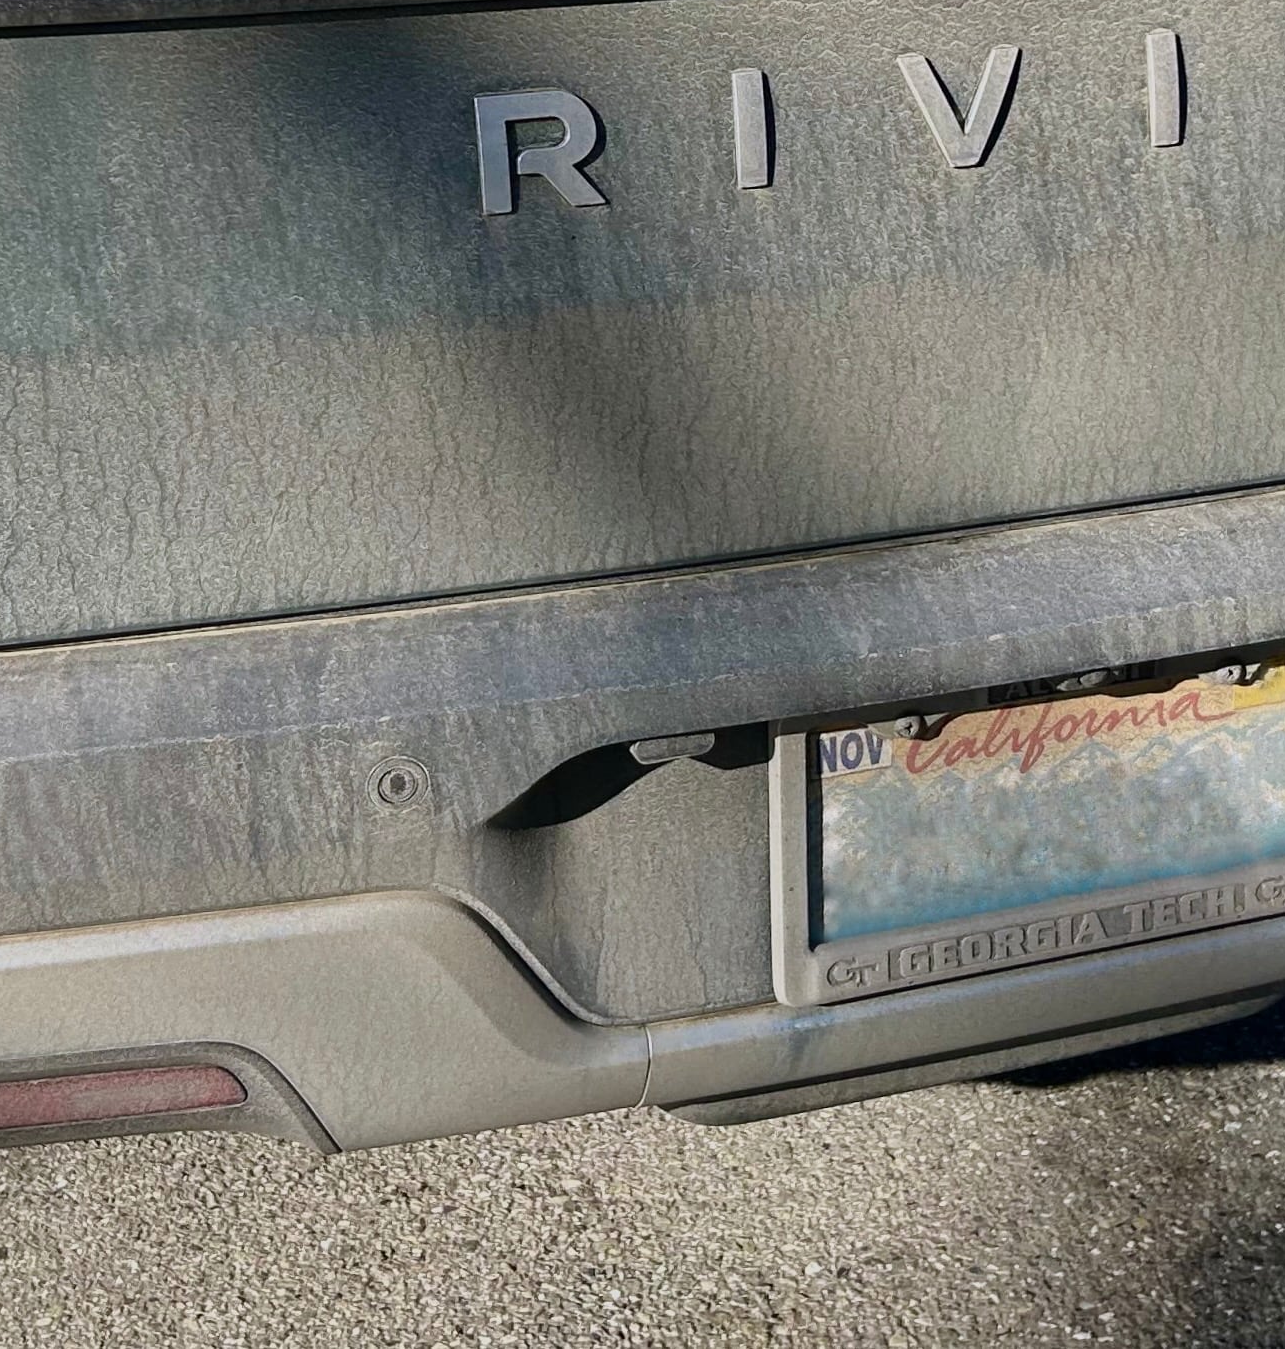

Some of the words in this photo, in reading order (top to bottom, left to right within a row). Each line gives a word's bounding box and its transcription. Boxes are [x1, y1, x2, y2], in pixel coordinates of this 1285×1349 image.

[818, 731, 884, 773] NOV
[906, 689, 1237, 774] California
[898, 911, 1110, 979] GEORGIA
[1123, 884, 1237, 934] TECH
